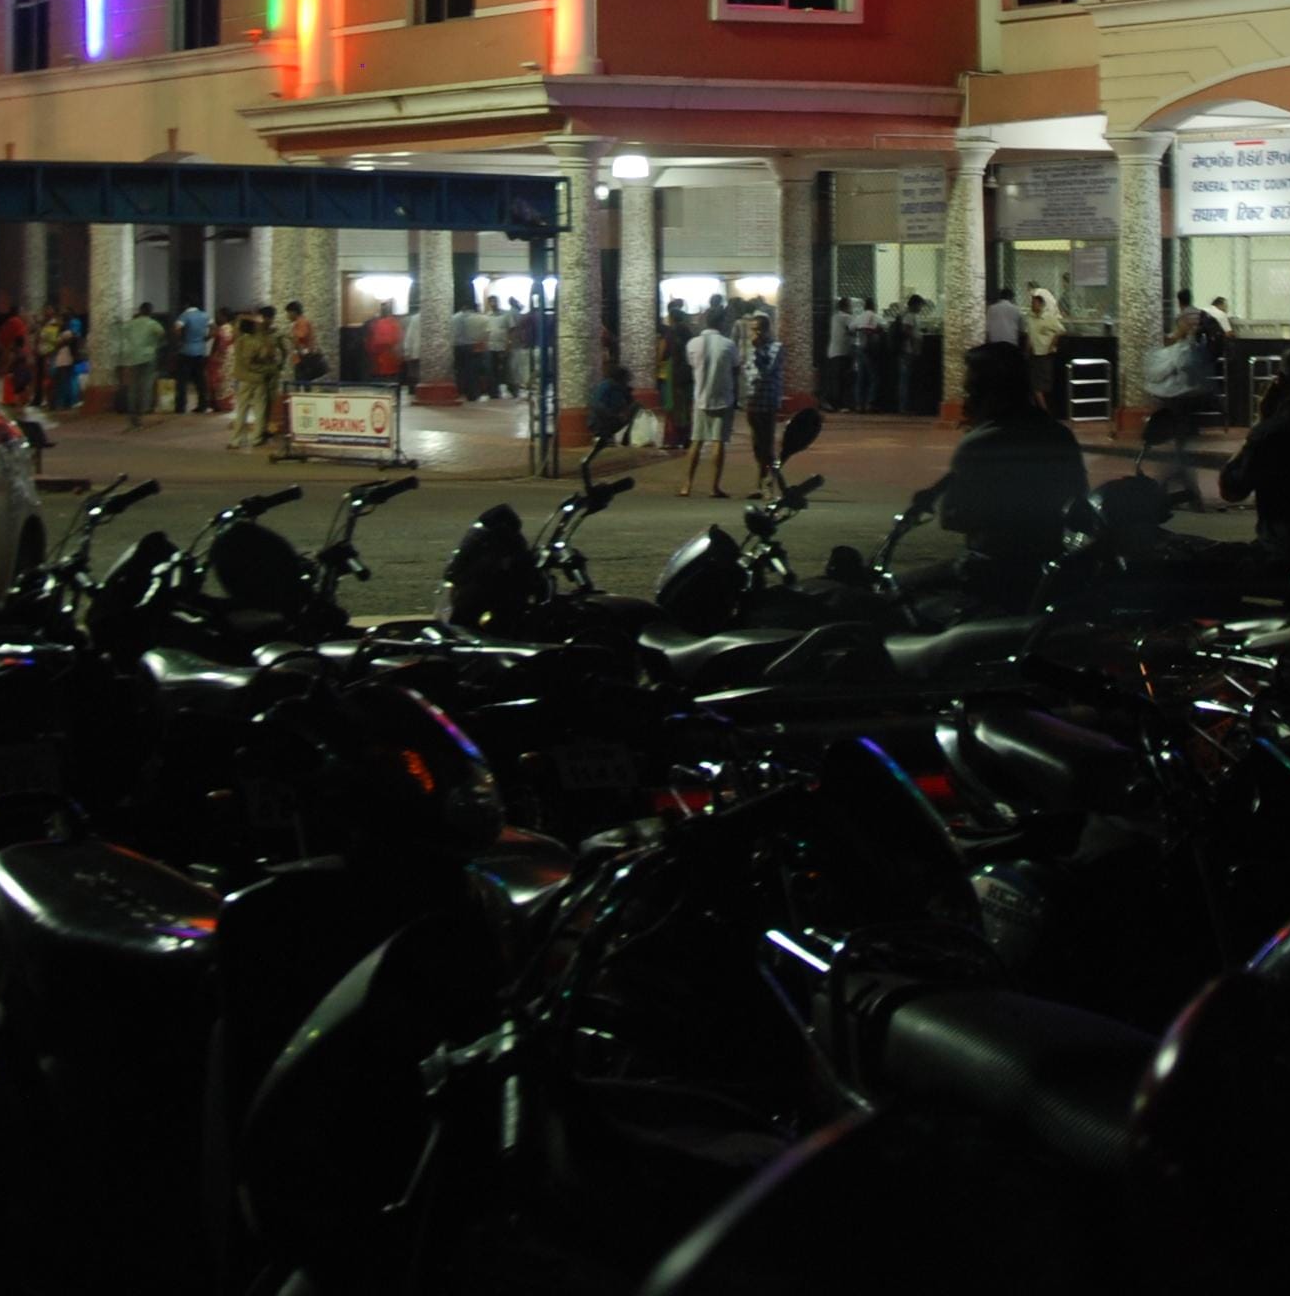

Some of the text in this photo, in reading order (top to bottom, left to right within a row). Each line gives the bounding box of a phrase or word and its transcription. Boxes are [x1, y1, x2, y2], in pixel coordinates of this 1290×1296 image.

[1191, 180, 1228, 192] GENERAL
[1231, 178, 1261, 192] TICKET
[334, 400, 350, 414] NO
[318, 417, 366, 433] PARKING
